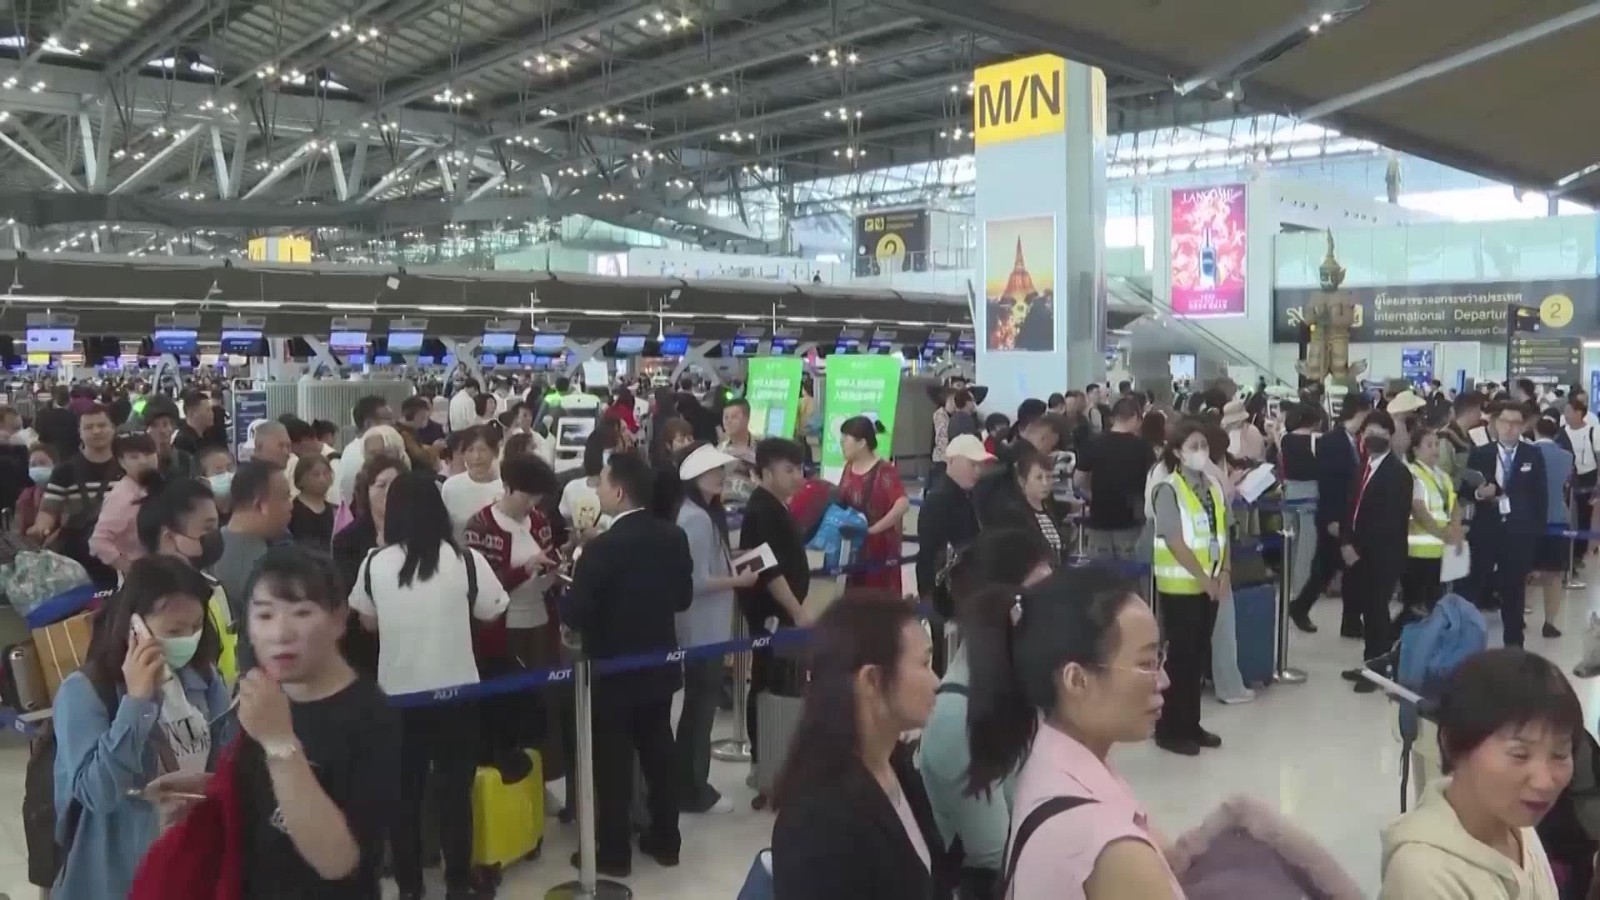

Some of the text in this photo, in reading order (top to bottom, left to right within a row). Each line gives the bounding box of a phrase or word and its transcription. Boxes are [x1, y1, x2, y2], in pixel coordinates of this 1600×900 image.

[979, 69, 1061, 128] M/N
[1374, 308, 1507, 322] International Departur
[1550, 302, 1562, 319] 2
